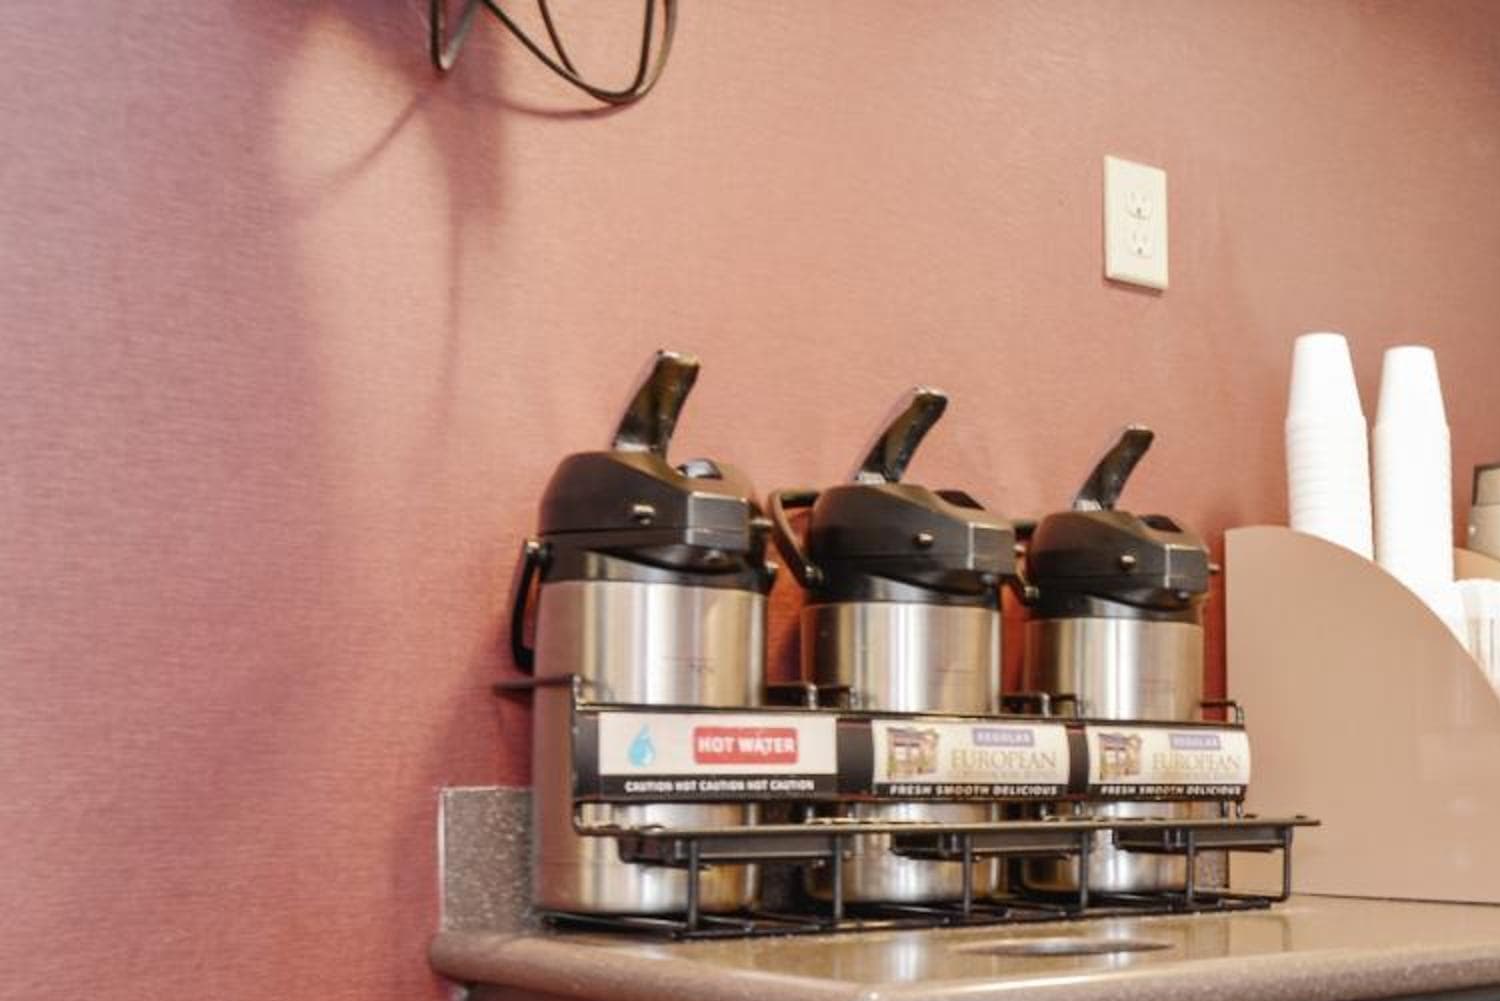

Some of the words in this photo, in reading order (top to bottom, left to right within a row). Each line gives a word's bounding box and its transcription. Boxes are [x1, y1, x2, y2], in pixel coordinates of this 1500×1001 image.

[696, 736, 735, 754] HOT
[736, 736, 796, 755] WATER
[950, 749, 1057, 770] EUROPEAN
[1151, 751, 1241, 770] EUROPEAN
[624, 780, 673, 793] CAUTION
[674, 780, 697, 792] HOT
[698, 779, 745, 792] CAUTION
[746, 779, 768, 791] HOT
[769, 779, 815, 792] CAUTION
[889, 785, 933, 796] FRESH
[935, 785, 990, 796] SMOOTH
[992, 785, 1058, 796] DELICIOUS
[1100, 785, 1137, 796] FRESH
[1139, 785, 1185, 796] SMOOTH
[1186, 785, 1242, 796] DELICIOUS
